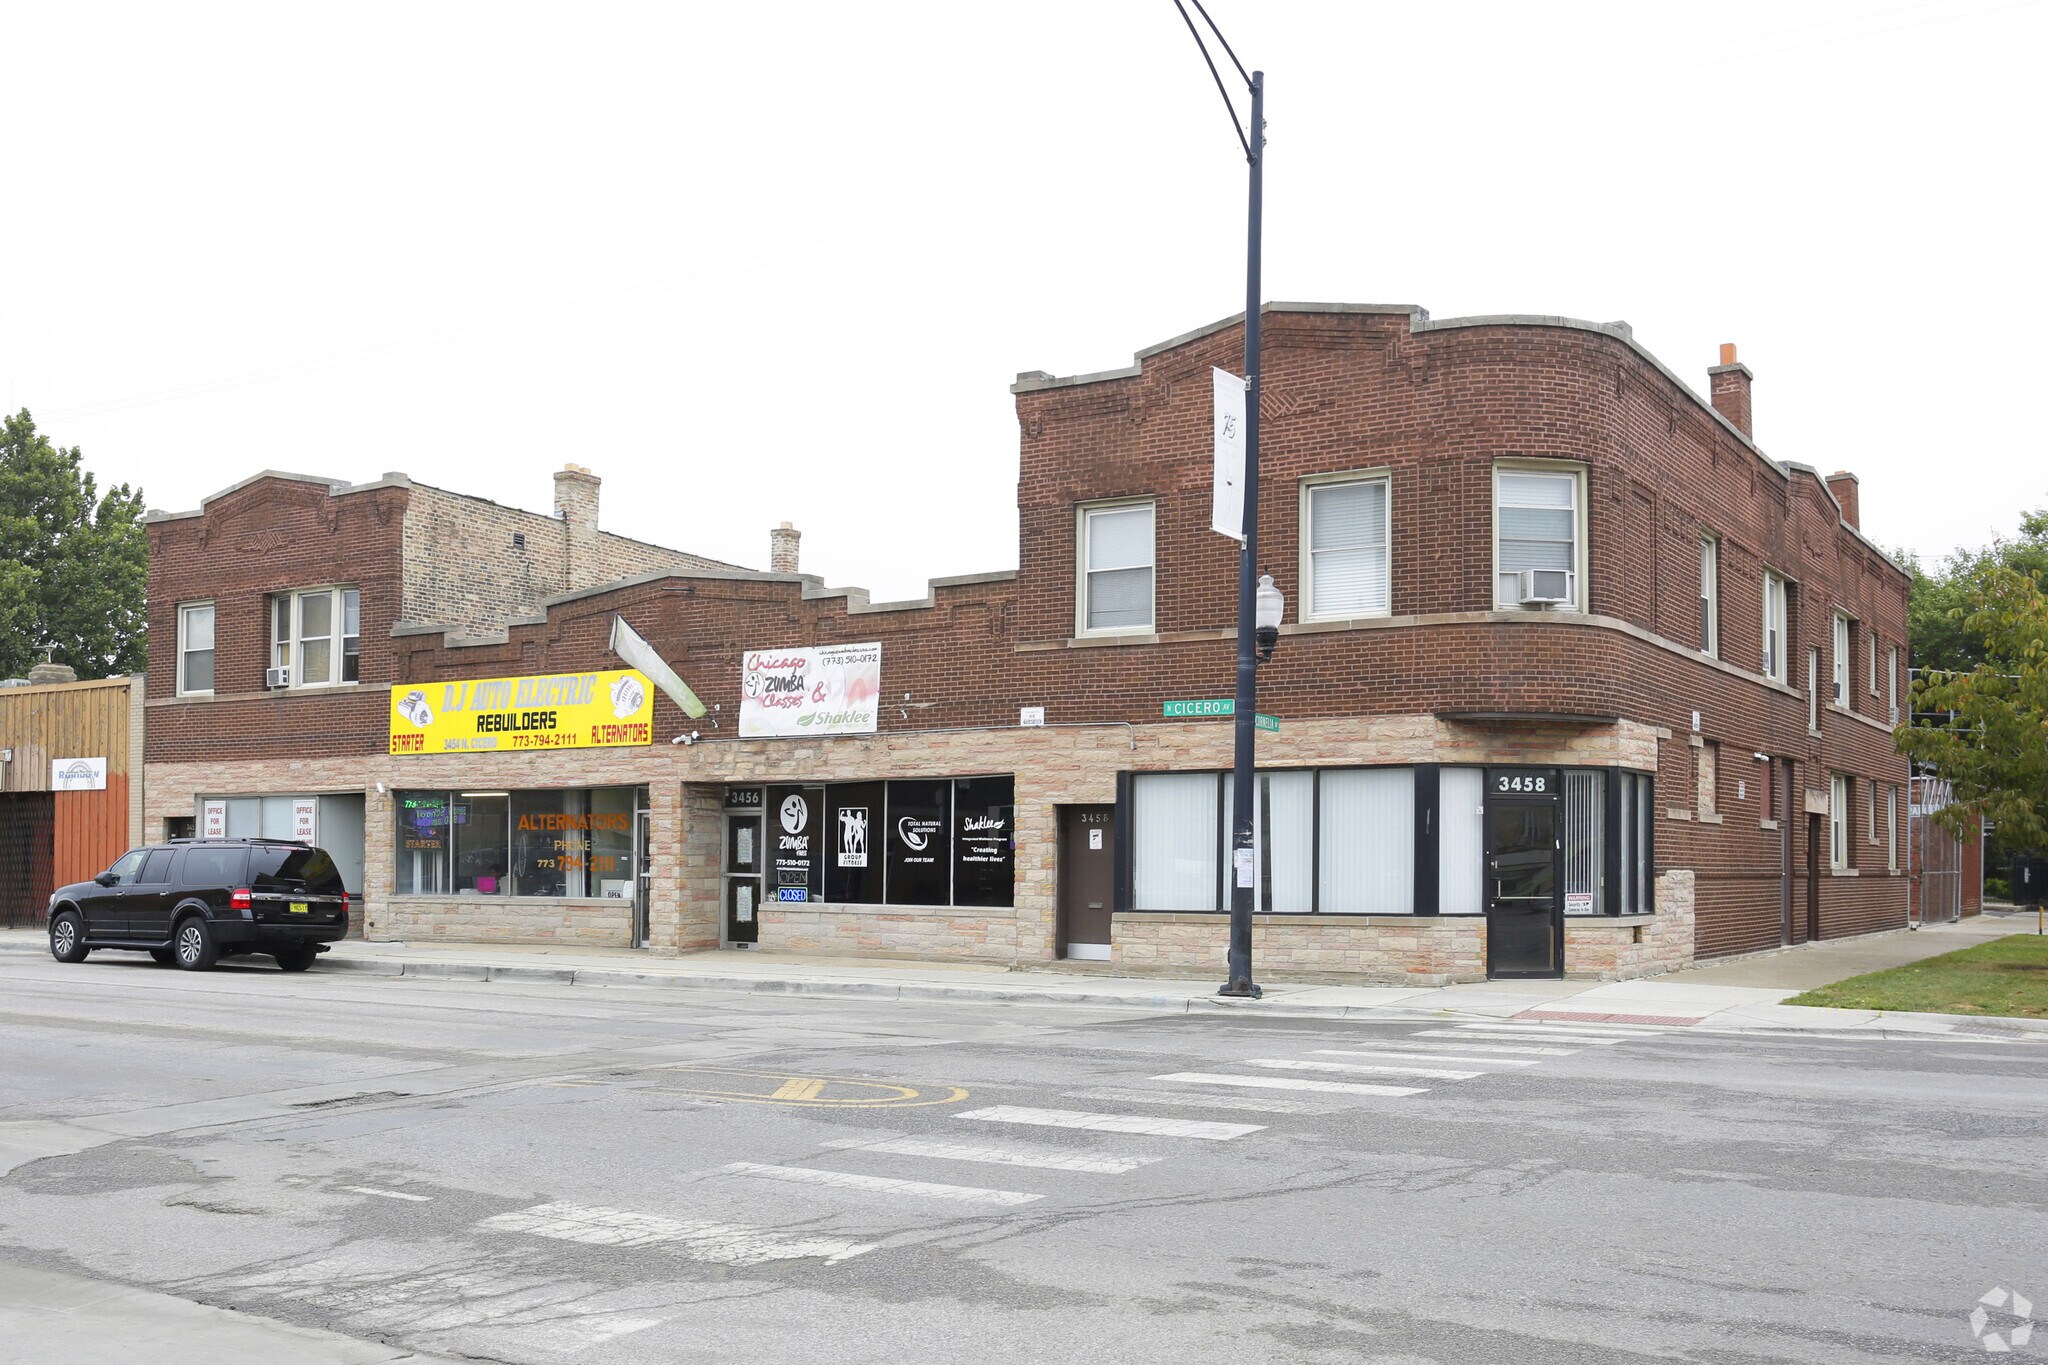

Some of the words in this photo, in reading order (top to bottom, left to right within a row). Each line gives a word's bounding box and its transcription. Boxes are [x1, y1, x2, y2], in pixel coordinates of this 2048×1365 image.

[1222, 414, 1236, 439] 75
[747, 654, 806, 675] Chicago
[822, 656, 843, 666] (773)
[845, 654, 877, 664] 510-0172
[765, 675, 805, 693] ZUMBA
[470, 681, 512, 711] AUTO
[514, 674, 597, 710] ELECTRIC
[763, 693, 804, 709] Classes
[811, 681, 826, 703] &
[1174, 702, 1220, 714] CICERO
[477, 711, 557, 732] REBUILDERS
[815, 710, 871, 725] Shaklee
[1255, 715, 1274, 729] CORNELIA
[392, 734, 425, 752] STARTER
[444, 738, 460, 750] 3454
[470, 737, 497, 749] CICERO
[513, 734, 577, 747] 773-794-2111
[591, 723, 648, 744] ALTERNATORS
[1499, 776, 1545, 791] 3458
[732, 792, 760, 803] 3456
[208, 807, 223, 815] OFFICE
[296, 806, 313, 814] OFFICE
[210, 817, 220, 825] FOR
[299, 817, 309, 825] FOR
[517, 813, 628, 830] ALTERNATORS
[963, 816, 995, 831] Shaklee
[208, 828, 222, 836] LEASE
[297, 828, 312, 836] LEASE
[405, 840, 441, 849] STARTER
[554, 840, 590, 851] PHONE
[779, 836, 808, 850] ZUMBA
[971, 847, 997, 855] "Creating
[537, 860, 555, 868] 773
[557, 856, 615, 872] 794-2111
[780, 872, 806, 883] OPEN
[780, 889, 806, 901] CLOSED
